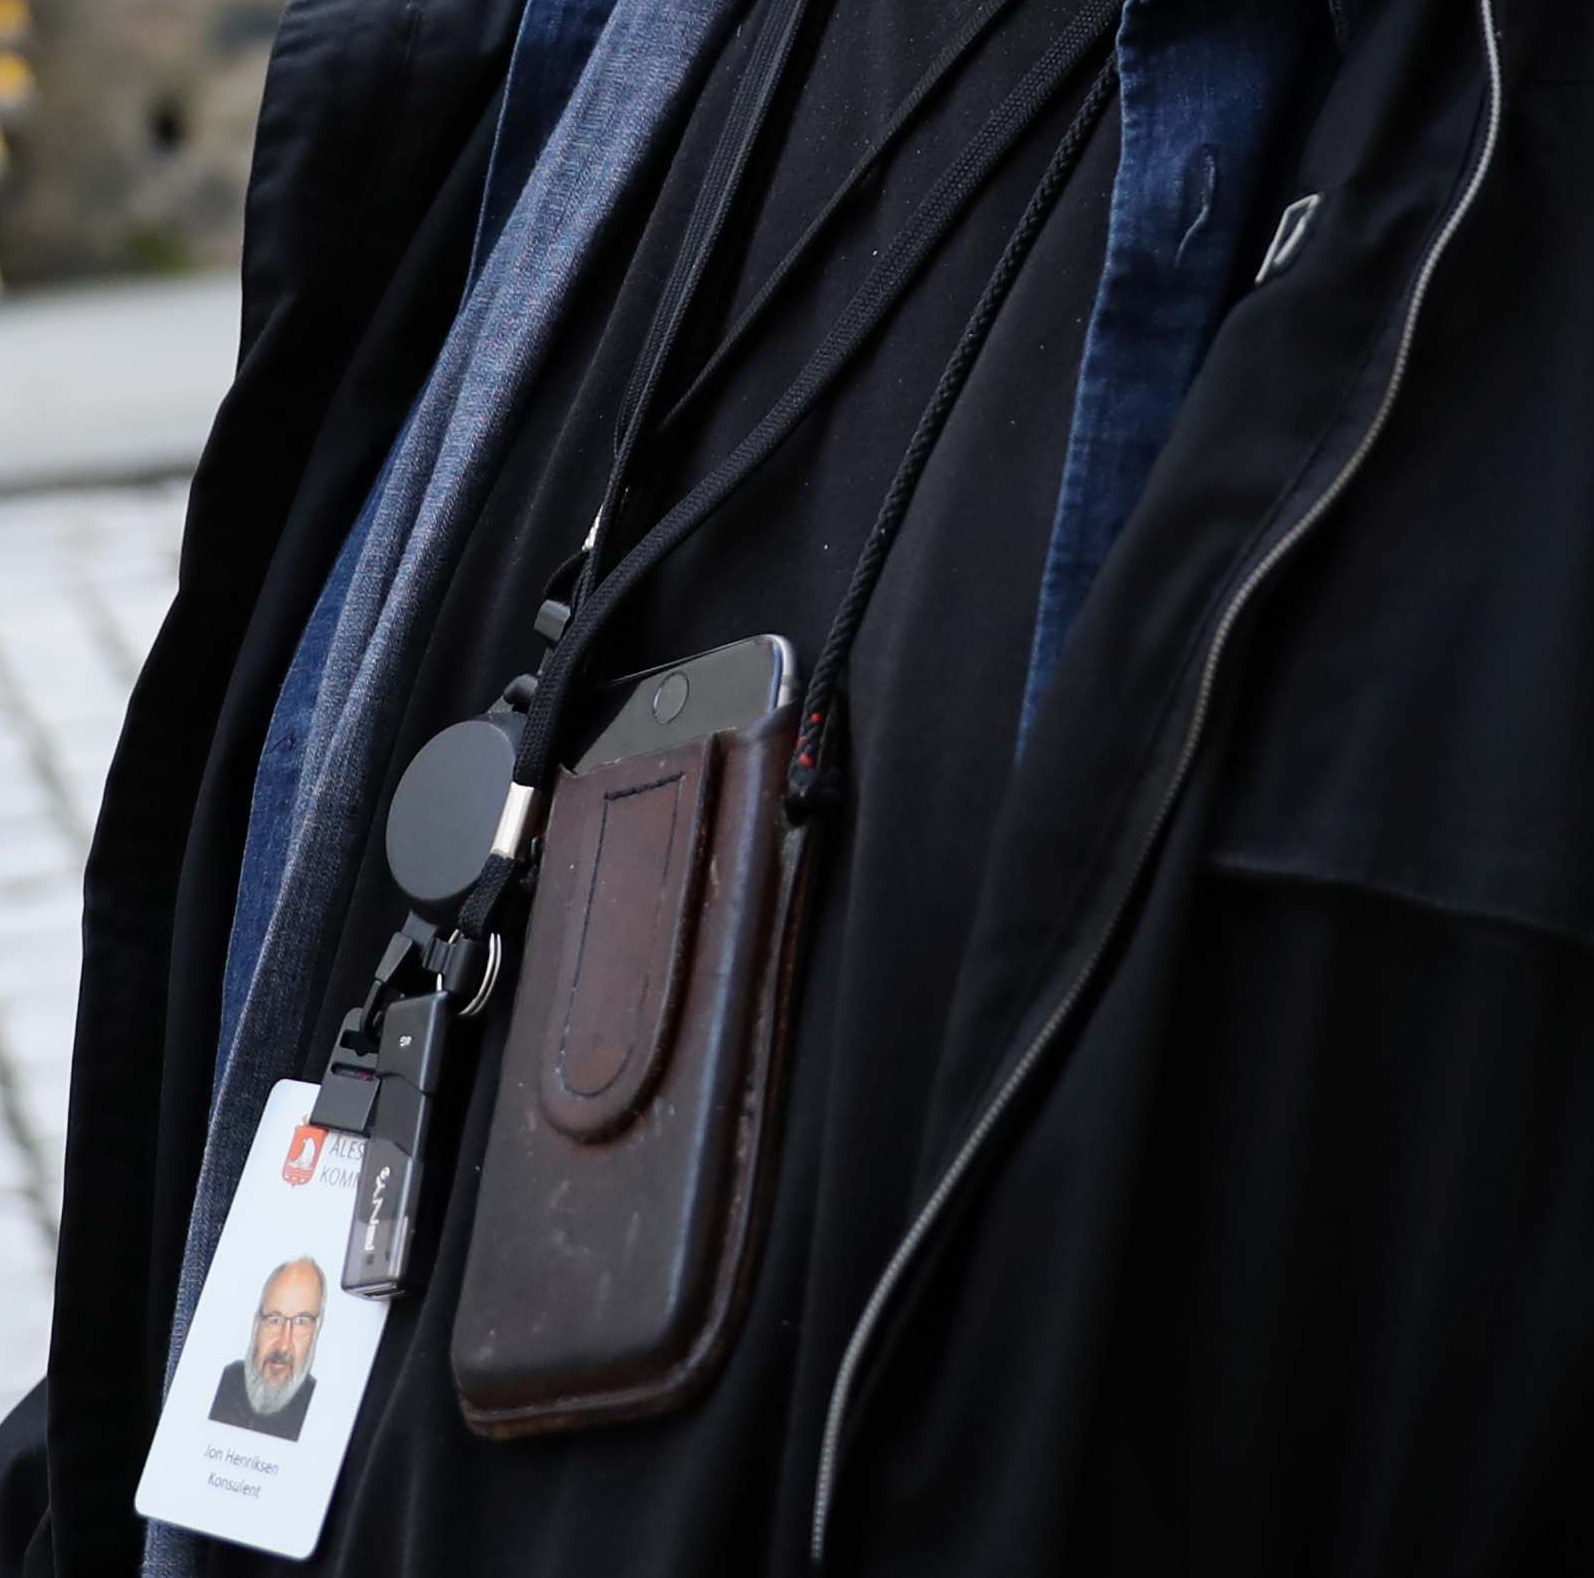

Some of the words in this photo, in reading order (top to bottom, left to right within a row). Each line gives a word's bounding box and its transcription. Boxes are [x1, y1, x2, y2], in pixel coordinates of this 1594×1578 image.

[204, 1445, 223, 1461] Jon
[225, 1448, 279, 1476] Henriksen
[208, 1472, 261, 1499] Konsulent
